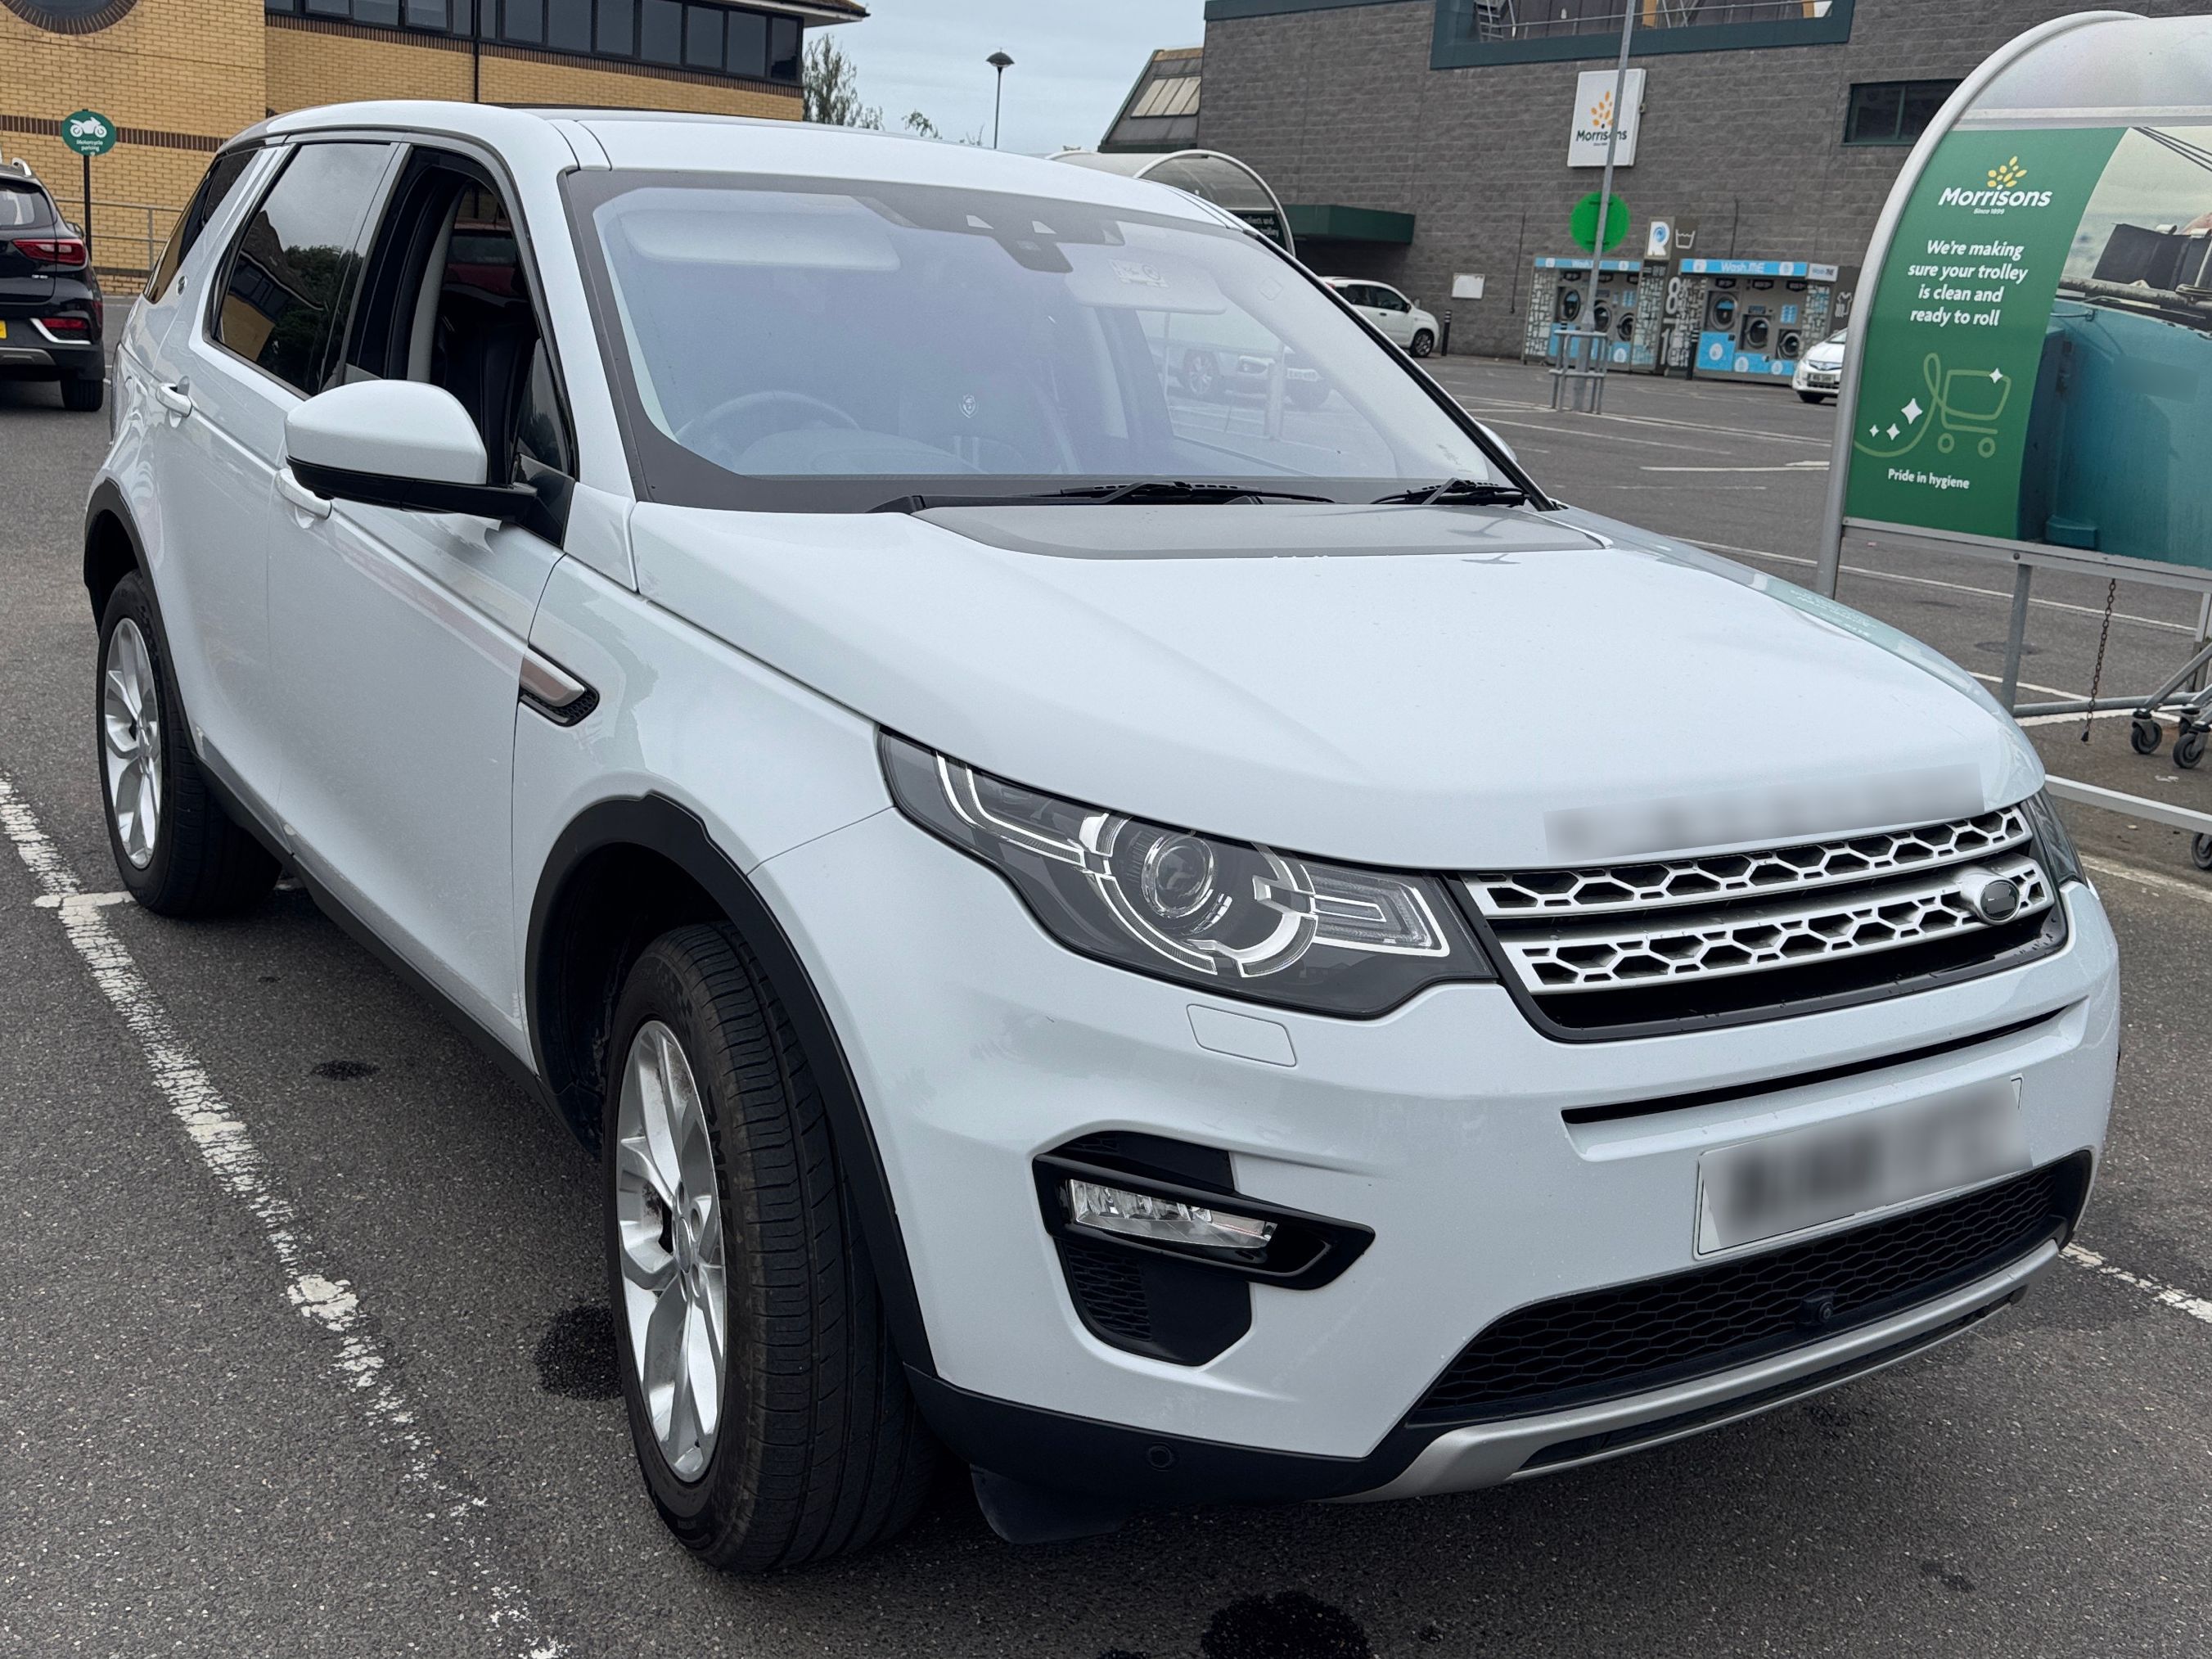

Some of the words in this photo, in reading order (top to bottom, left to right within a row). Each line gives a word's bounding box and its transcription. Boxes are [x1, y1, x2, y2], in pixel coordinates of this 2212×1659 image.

[1575, 129, 1628, 142] Morrisns
[1938, 185, 2053, 207] Morrisons
[1990, 207, 2005, 215] 1899
[1926, 239, 1967, 255] We're
[1968, 240, 2025, 261] making
[1908, 264, 1939, 277] sure
[1939, 265, 1976, 281] your
[1978, 264, 2029, 285] trolley
[1918, 284, 1930, 300] is
[1933, 284, 1971, 301] clean
[1974, 286, 2004, 303] and
[1910, 306, 1951, 327] ready
[1954, 309, 1970, 324] to
[1973, 309, 2001, 327] roll
[1888, 468, 1915, 482] Pride
[1917, 471, 1926, 484] in
[1929, 472, 1970, 489] hygiene
